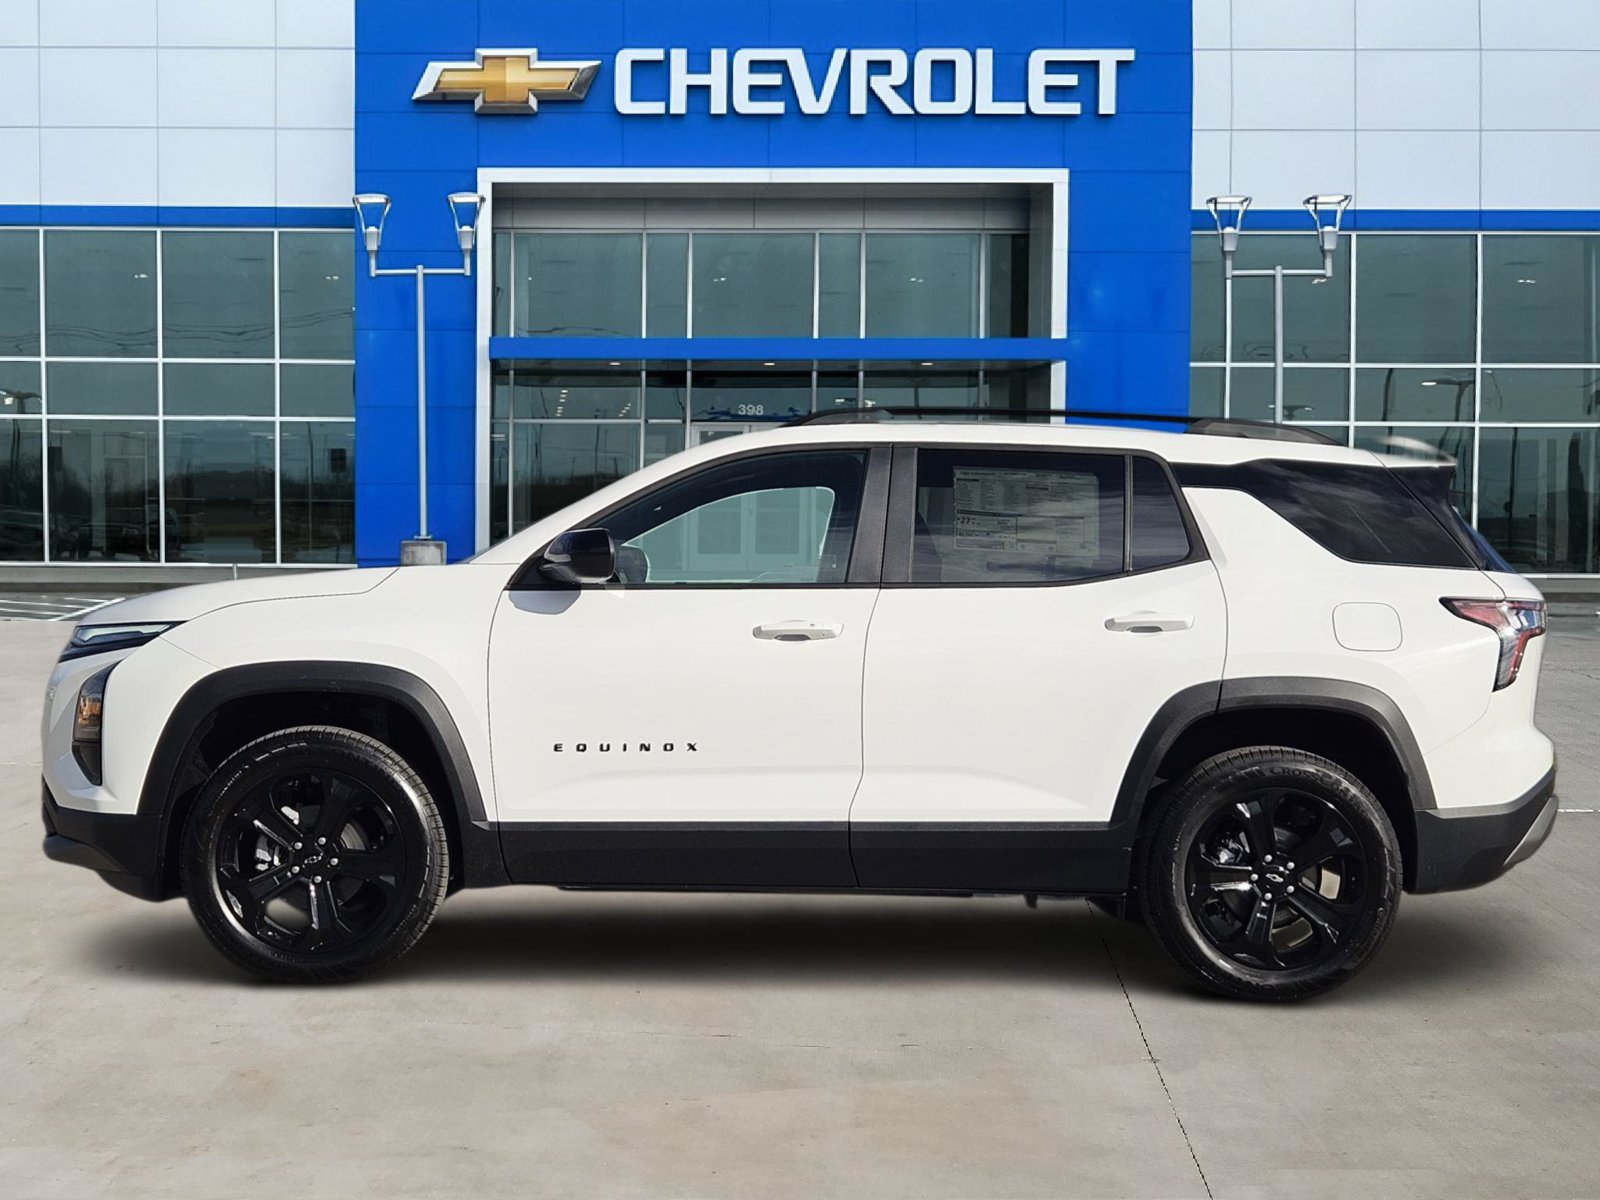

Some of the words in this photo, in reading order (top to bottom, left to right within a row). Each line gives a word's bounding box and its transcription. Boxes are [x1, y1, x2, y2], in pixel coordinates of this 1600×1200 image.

[614, 47, 1135, 115] CHEVROLET
[737, 404, 764, 415] 398
[553, 743, 698, 752] EQUINOX
